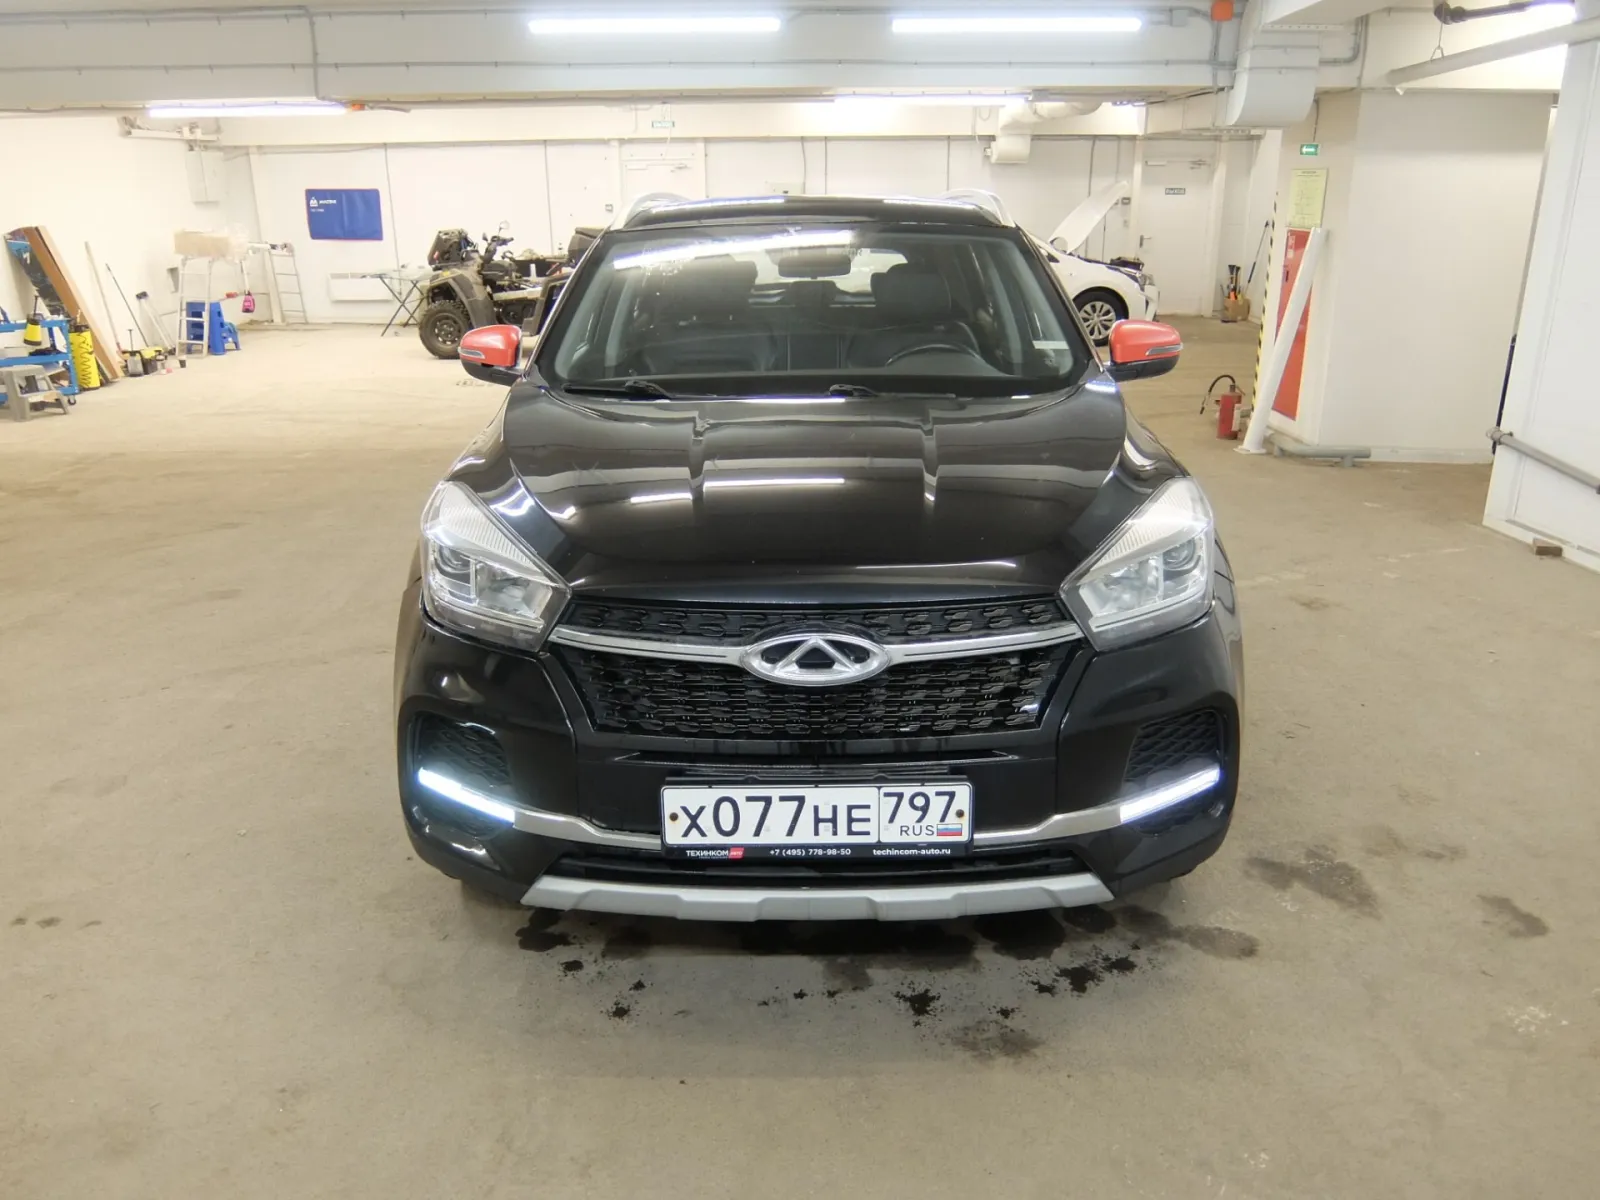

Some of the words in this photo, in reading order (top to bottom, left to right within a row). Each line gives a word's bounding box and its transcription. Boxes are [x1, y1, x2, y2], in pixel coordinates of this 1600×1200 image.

[883, 791, 957, 824] 797
[899, 824, 935, 837] RUS
[769, 848, 780, 856] +7
[782, 848, 806, 857] (495)
[808, 848, 852, 856] 778-98-50
[872, 847, 951, 856] techincom-auto.ru
